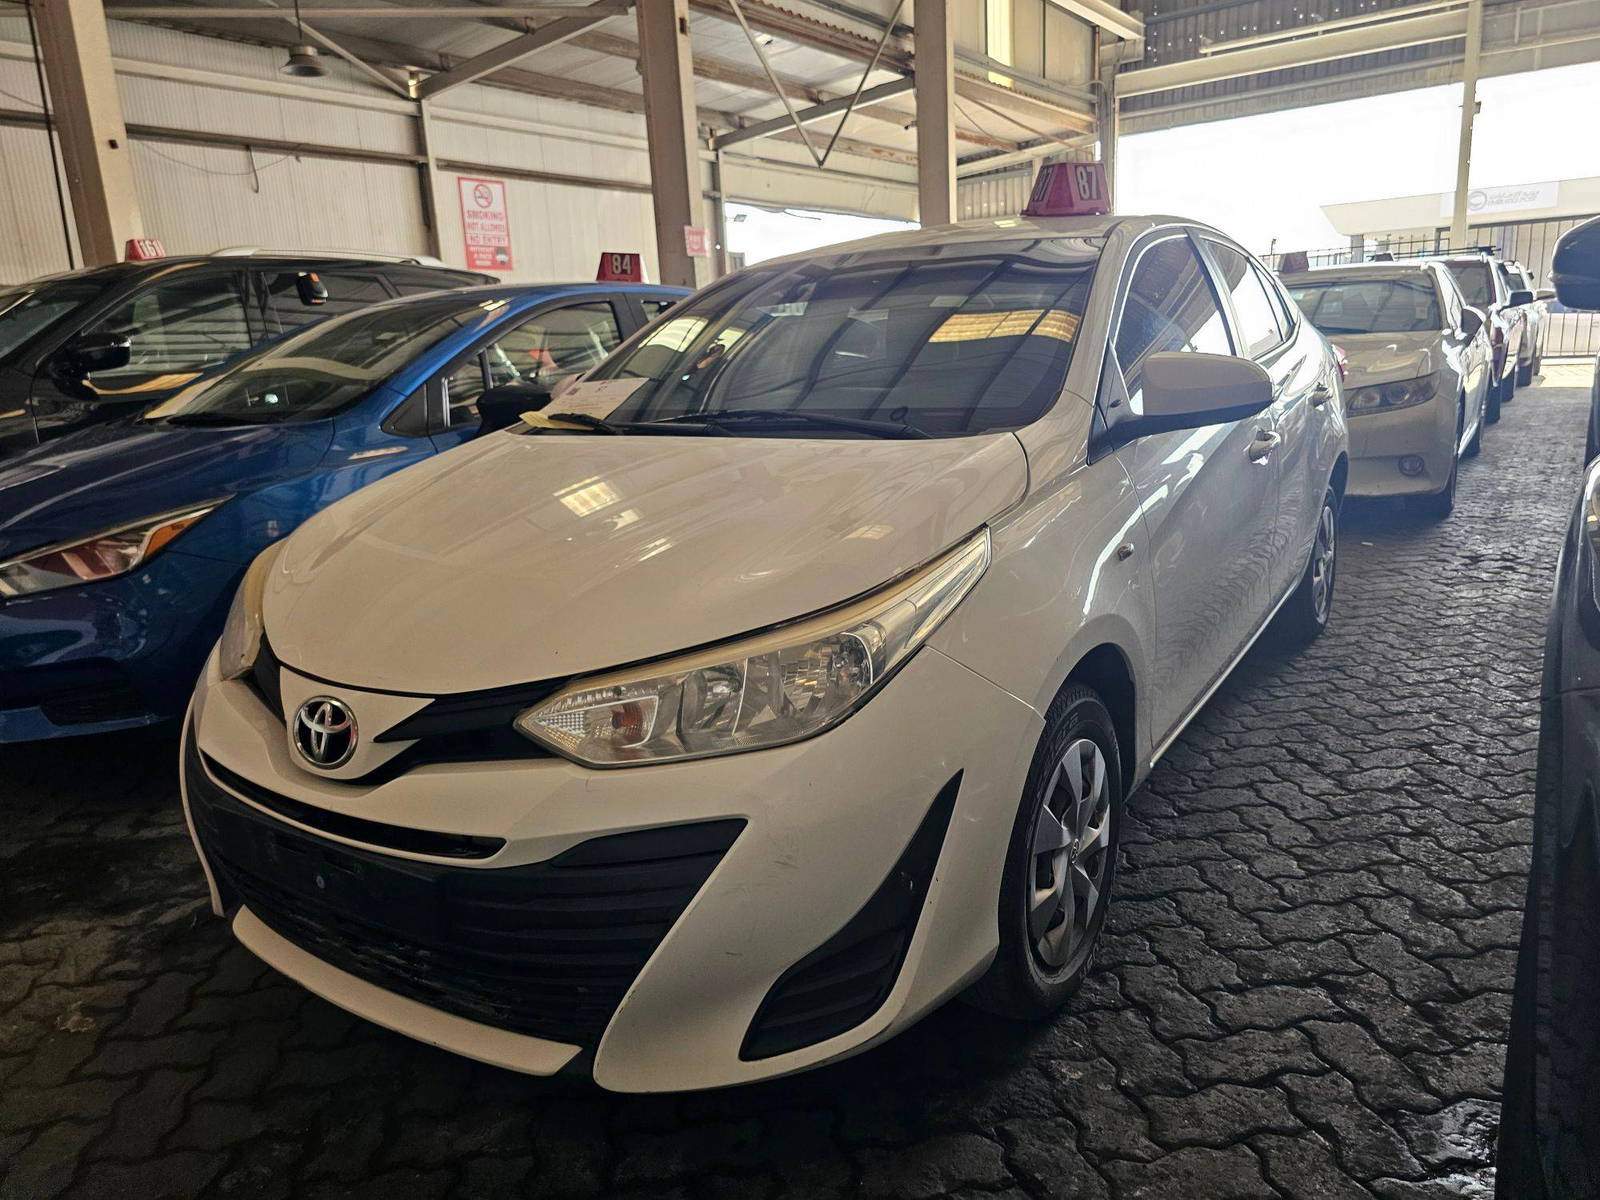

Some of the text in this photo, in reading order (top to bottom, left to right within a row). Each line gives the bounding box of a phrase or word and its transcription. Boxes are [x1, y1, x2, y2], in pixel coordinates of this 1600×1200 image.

[1076, 165, 1098, 200] 87
[467, 209, 504, 221] SMOKING
[467, 222, 504, 233] NOT ALLOWED
[470, 235, 505, 244] NO ENTRY
[139, 240, 165, 257] 161
[612, 254, 632, 274] 84
